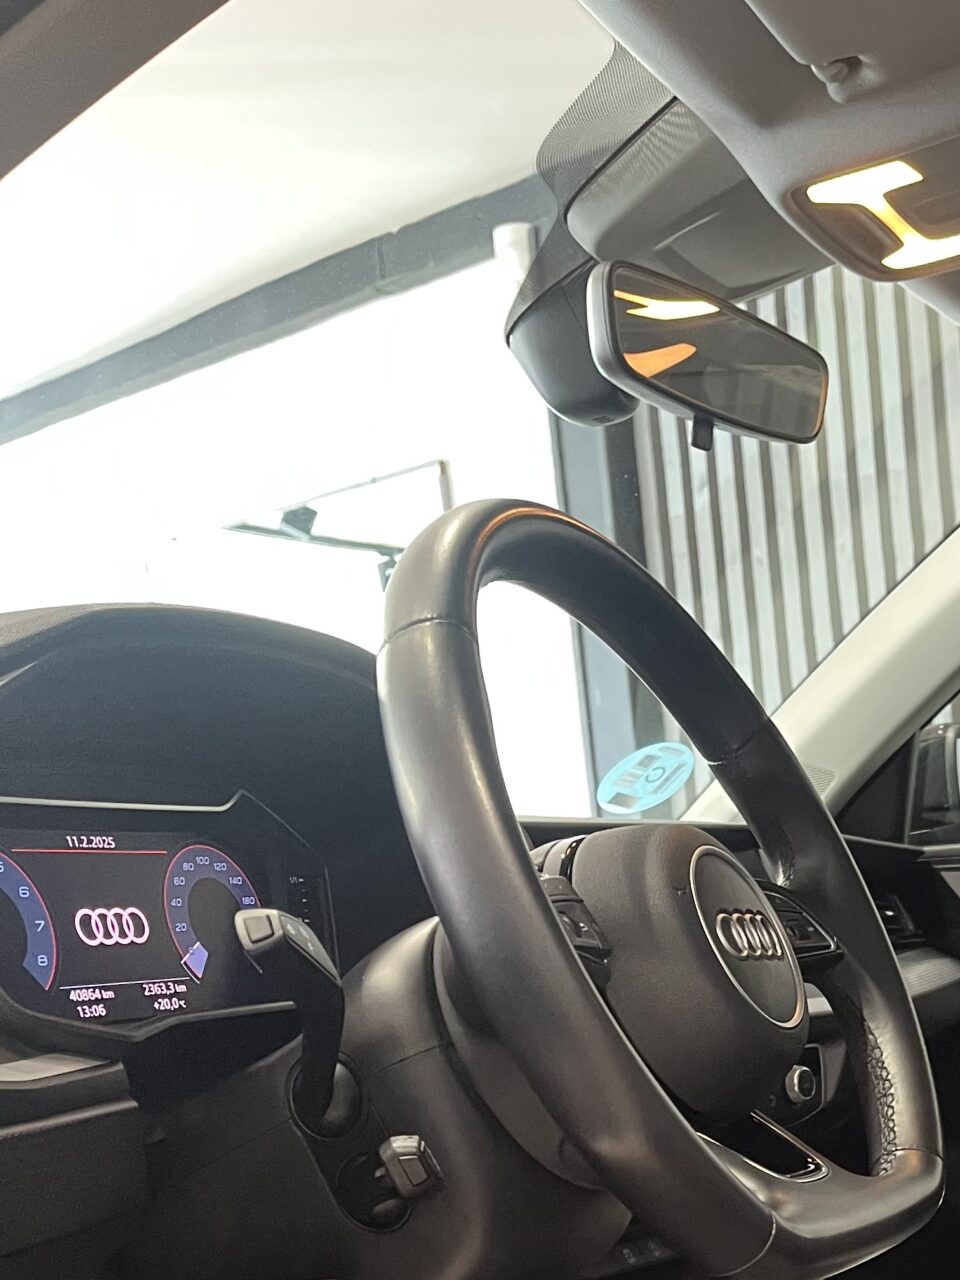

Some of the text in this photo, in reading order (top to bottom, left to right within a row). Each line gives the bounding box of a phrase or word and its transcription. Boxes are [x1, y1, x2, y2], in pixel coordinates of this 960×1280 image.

[65, 835, 116, 849] 11.2.2025
[195, 856, 210, 865] 100
[182, 862, 195, 871] 80
[213, 862, 227, 871] 120
[173, 876, 186, 886] 60
[229, 876, 243, 885] 140
[18, 886, 30, 898] 6
[170, 898, 182, 907] 40
[34, 920, 45, 932] 7
[175, 922, 187, 932] 20
[37, 954, 48, 967] 8
[142, 982, 175, 996] 2363,3
[69, 988, 115, 1002] 40864 km
[76, 1003, 107, 1018] 13:06
